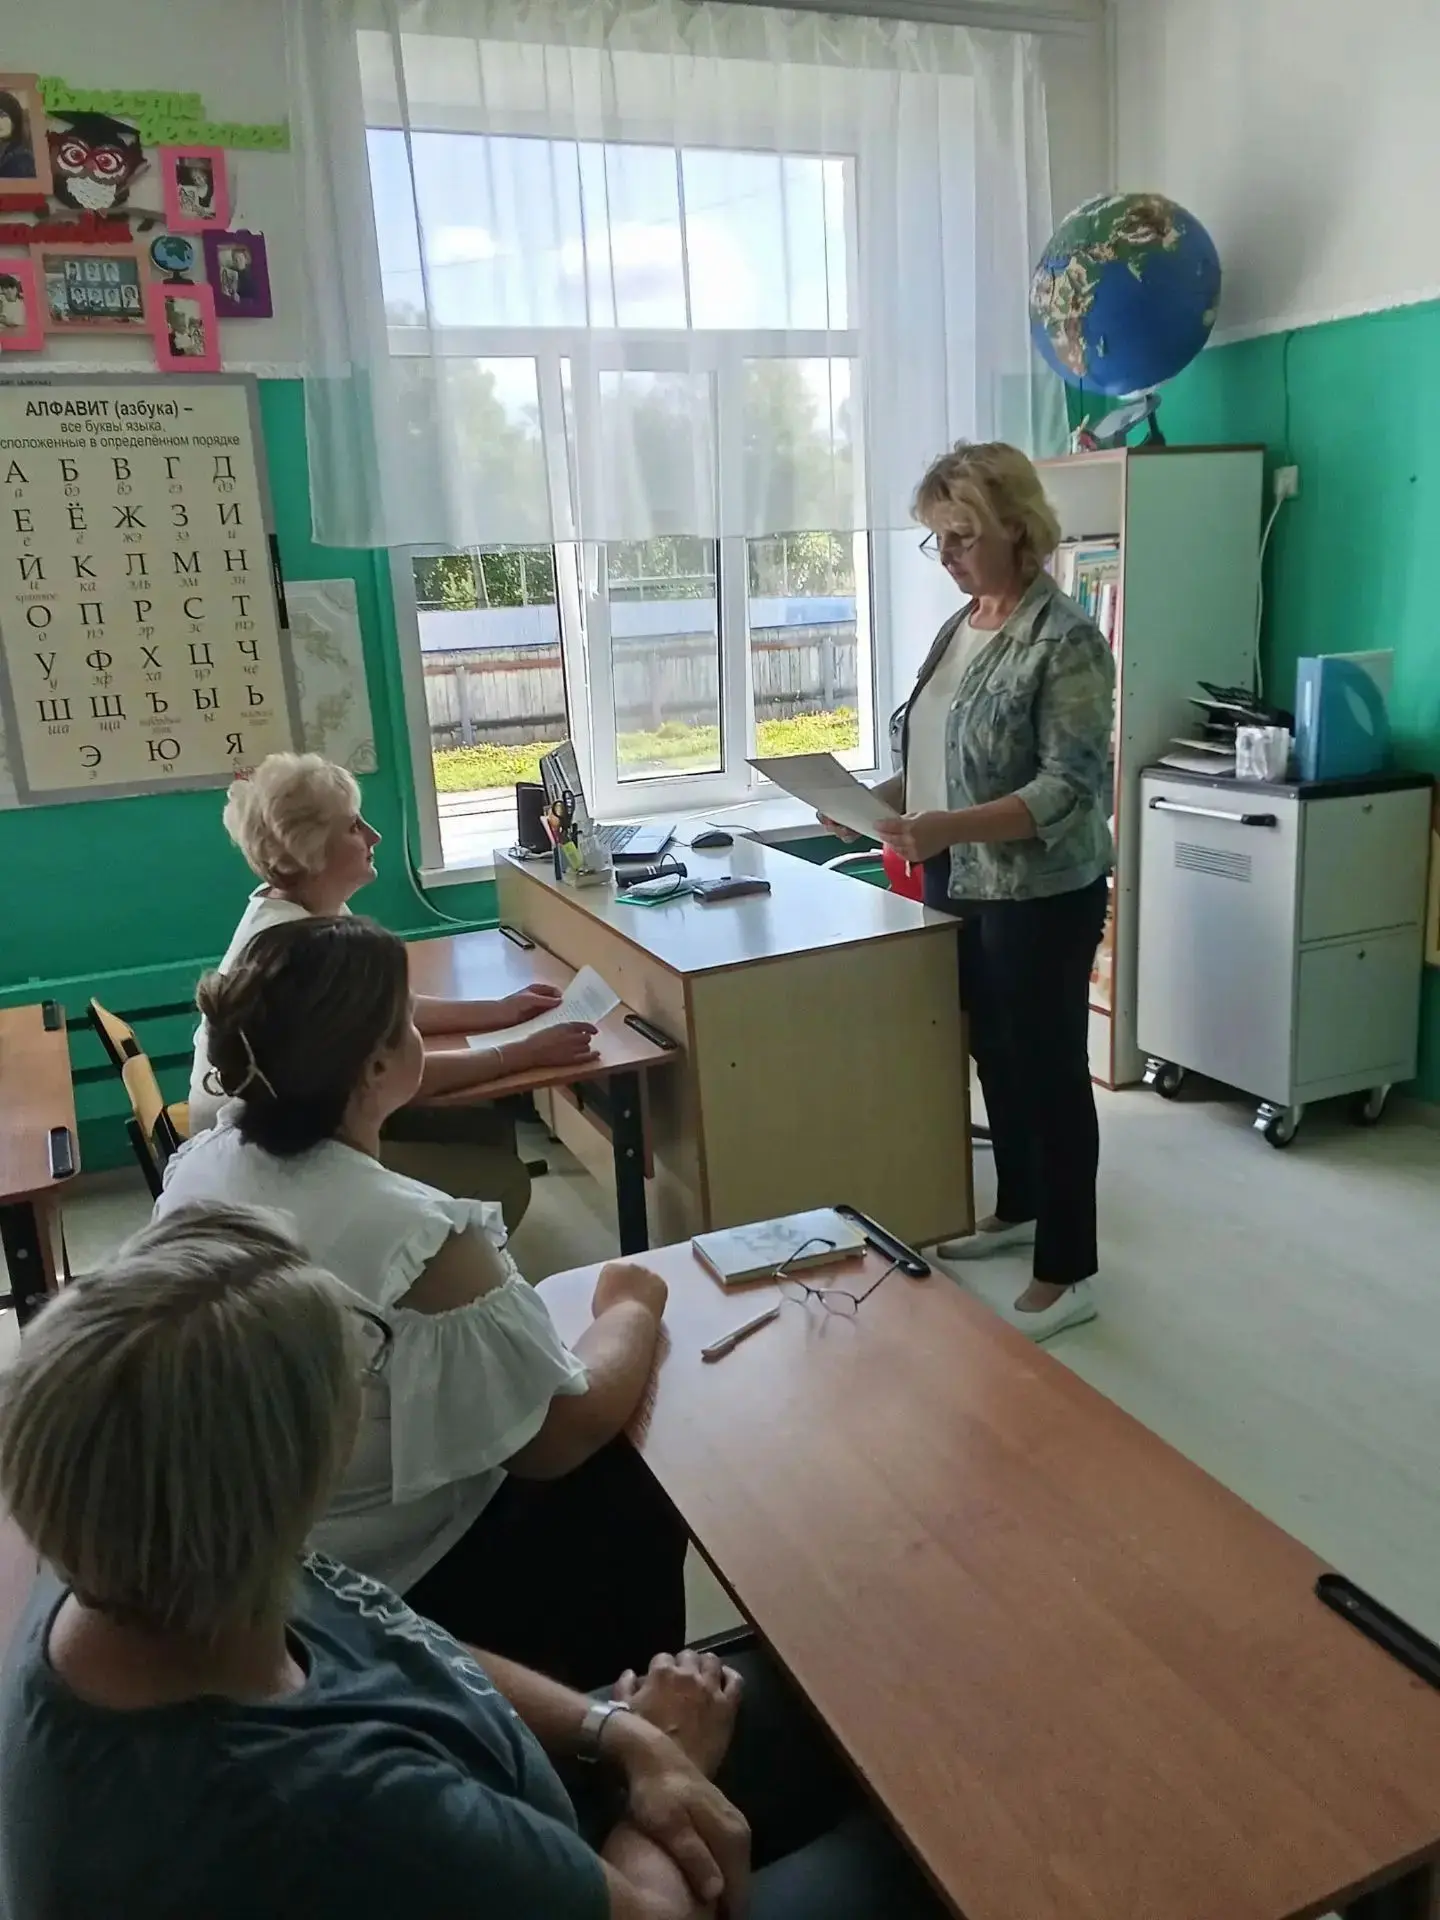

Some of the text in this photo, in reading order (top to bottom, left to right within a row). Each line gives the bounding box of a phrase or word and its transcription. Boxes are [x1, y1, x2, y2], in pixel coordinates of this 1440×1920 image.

[25, 400, 109, 417] АЛФАВИТ
[114, 400, 179, 419] (азбука)
[60, 422, 81, 433] все
[85, 420, 122, 435] буквы
[90, 437, 97, 447] в
[193, 435, 240, 448] порядке
[5, 456, 235, 483] А Б В Г Д
[13, 502, 242, 532] Е Ё Ж З И
[18, 549, 248, 581] Й К Л М Н
[26, 595, 251, 628] О П Р С Т
[35, 640, 261, 680] У Ф Х Ц Ч
[36, 698, 74, 722] Ш
[90, 694, 126, 721] Щ
[146, 691, 169, 714] Ъ
[193, 687, 220, 710] Ы
[247, 685, 264, 706] Ь
[79, 733, 244, 767] Э Ю Я
